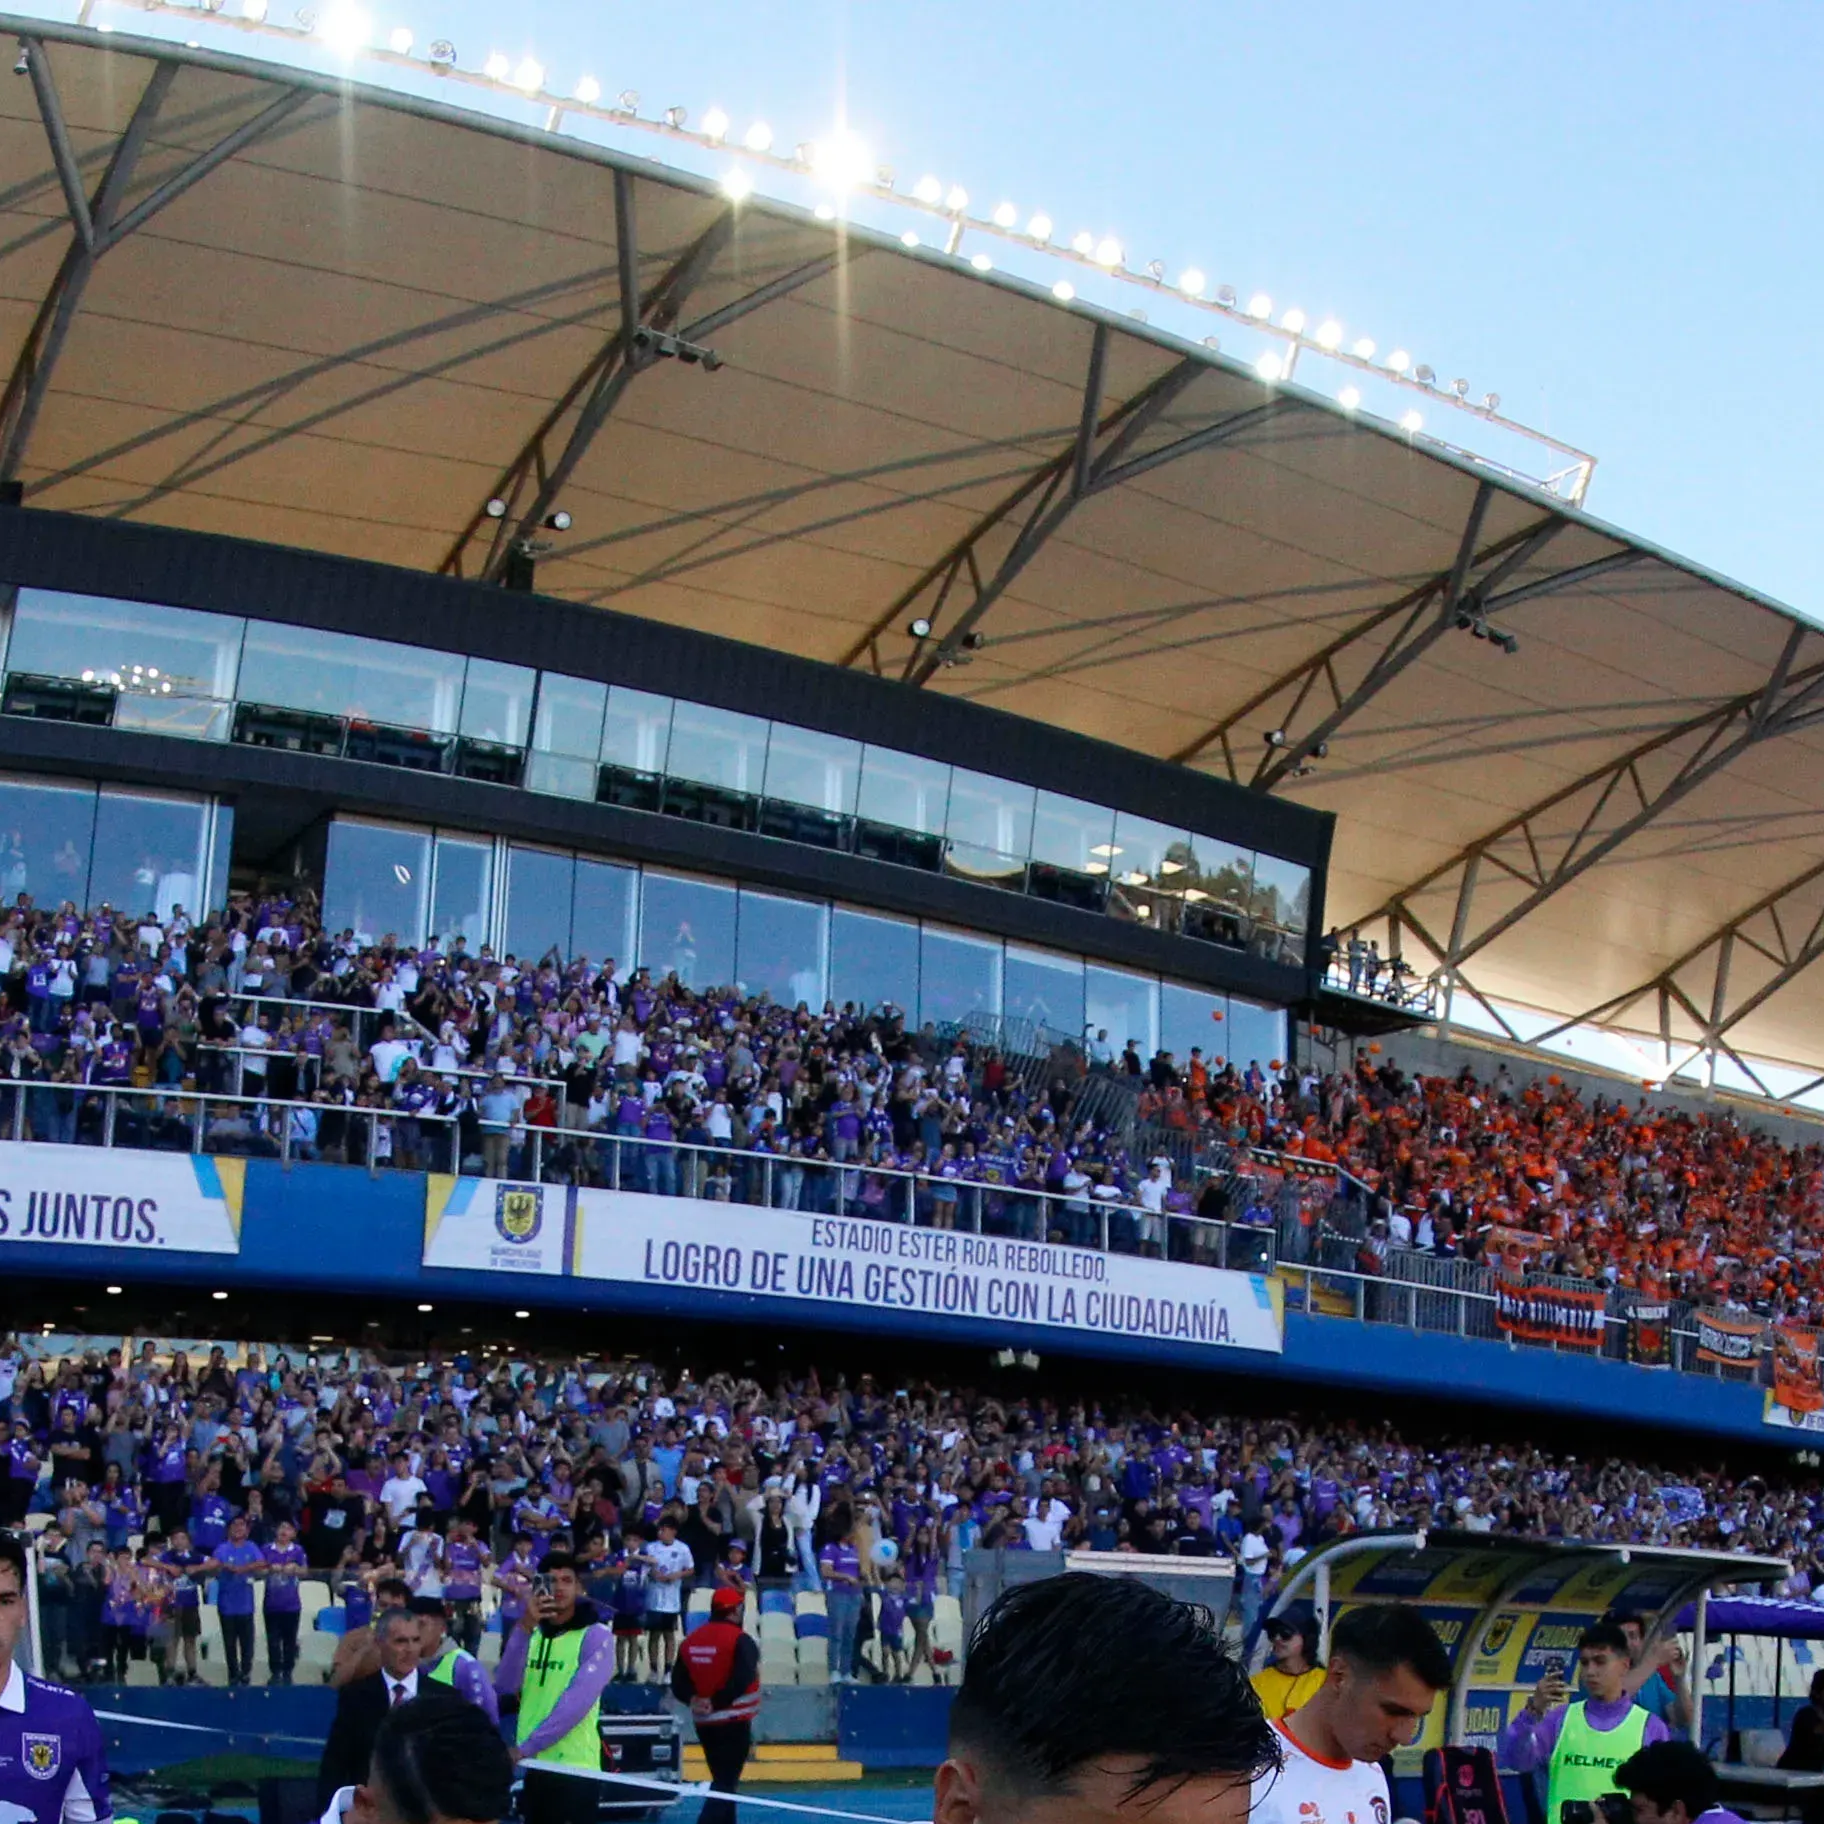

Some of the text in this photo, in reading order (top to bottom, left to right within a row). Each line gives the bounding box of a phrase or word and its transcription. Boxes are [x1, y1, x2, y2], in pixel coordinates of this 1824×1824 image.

[20, 1190, 166, 1245] JUNTOS.
[812, 1218, 1111, 1286] ESTADIO ESTER ROA REBOLLEDO,
[644, 1239, 1237, 1344] LOGRO DE UNA GESTIÓN CON LA CIUDADANÍA.
[1564, 1754, 1615, 1769] KELME
